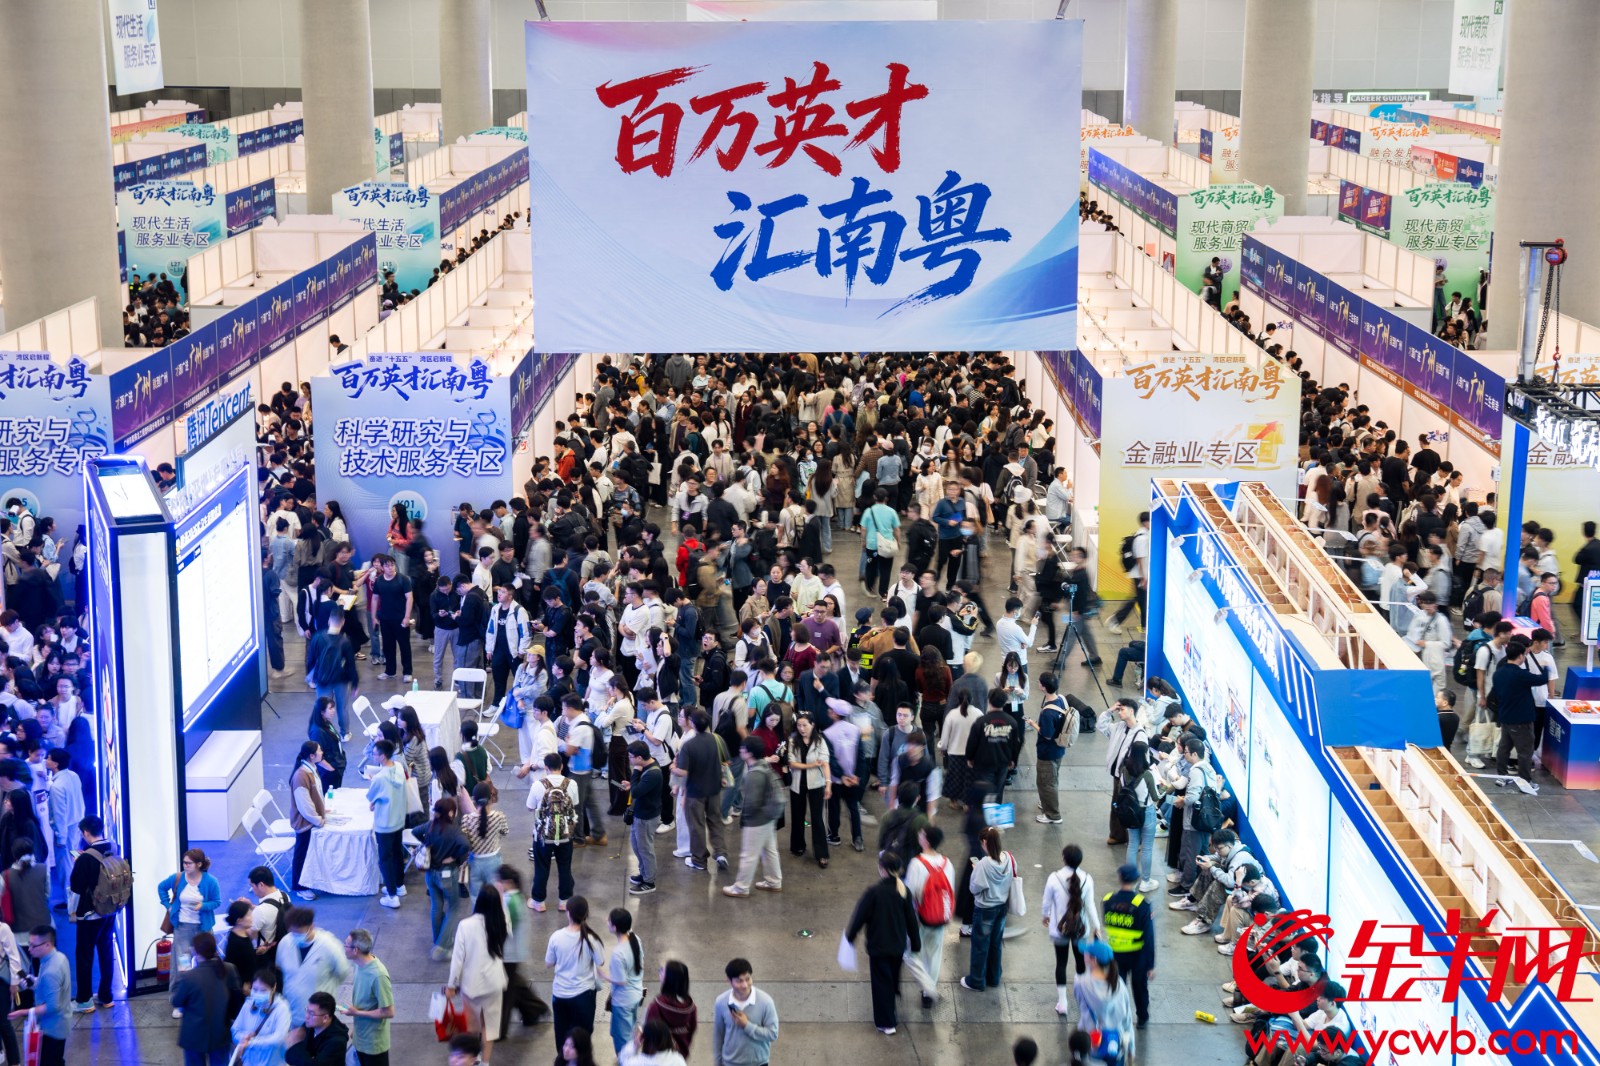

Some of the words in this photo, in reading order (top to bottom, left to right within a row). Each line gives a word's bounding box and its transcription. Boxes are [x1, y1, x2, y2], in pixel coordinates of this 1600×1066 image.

[115, 14, 143, 38] 现代生活
[124, 43, 157, 68] 服务业专区
[1350, 94, 1381, 102] CAREER
[596, 61, 928, 178] 百万英才
[128, 184, 216, 207] 百万英才汇南粤
[343, 186, 430, 209] 百万英才汇南粤
[1190, 187, 1275, 210] 百万英才汇南粤
[1405, 186, 1492, 209] 百万英才汇南粤
[133, 217, 191, 230] 现代生活
[1191, 220, 1248, 233] 现代商贸
[1405, 219, 1463, 232] 现代商贸
[136, 233, 209, 246] 服务业专区
[710, 170, 1011, 319] 汇南粤
[1406, 236, 1479, 248] 服务业专区
[331, 359, 493, 402] 百万英才汇南粤
[1124, 360, 1285, 402] 百万英才汇南粤
[336, 419, 469, 445] 科学研究与
[342, 448, 503, 474] 技术服务专区
[1125, 440, 1258, 465] 金融业专区
